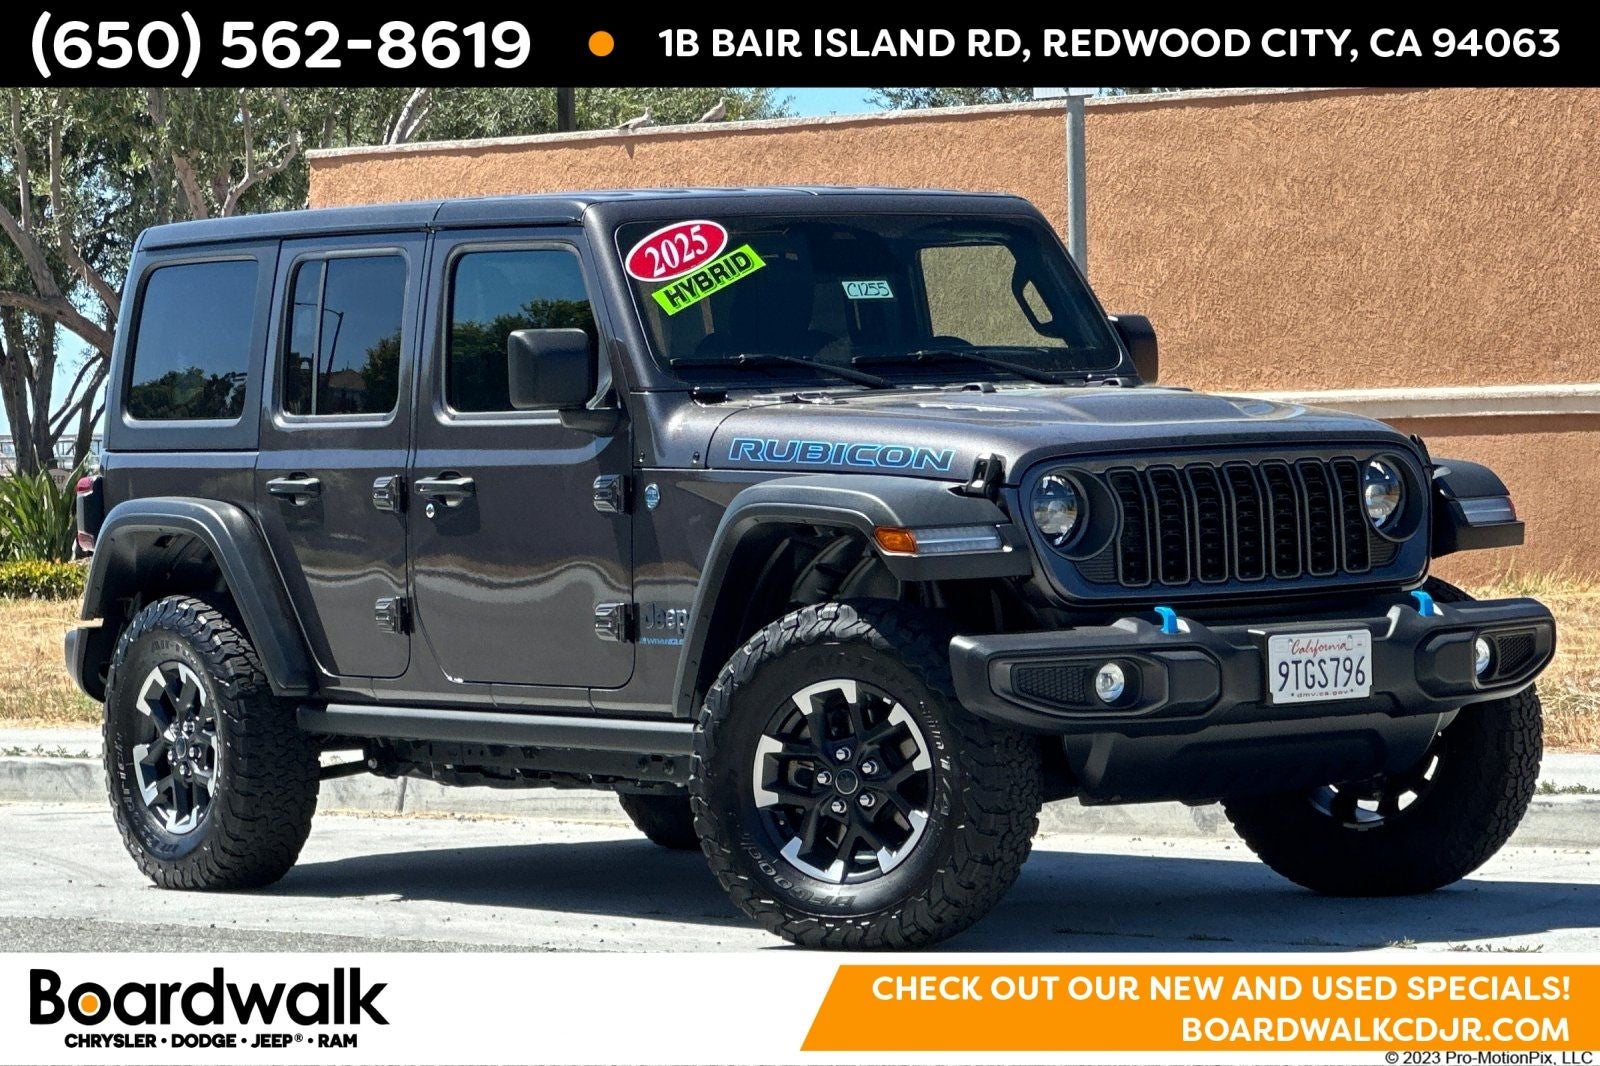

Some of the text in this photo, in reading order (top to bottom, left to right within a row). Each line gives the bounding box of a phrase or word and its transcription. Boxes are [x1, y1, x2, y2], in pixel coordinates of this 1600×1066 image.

[644, 225, 709, 277] 2025
[663, 251, 755, 309] HYBRID
[847, 282, 890, 297] C1255
[728, 438, 956, 472] RUBICON
[645, 602, 691, 637] Jeep
[1291, 639, 1353, 658] California
[1278, 656, 1366, 692] 9TGS796
